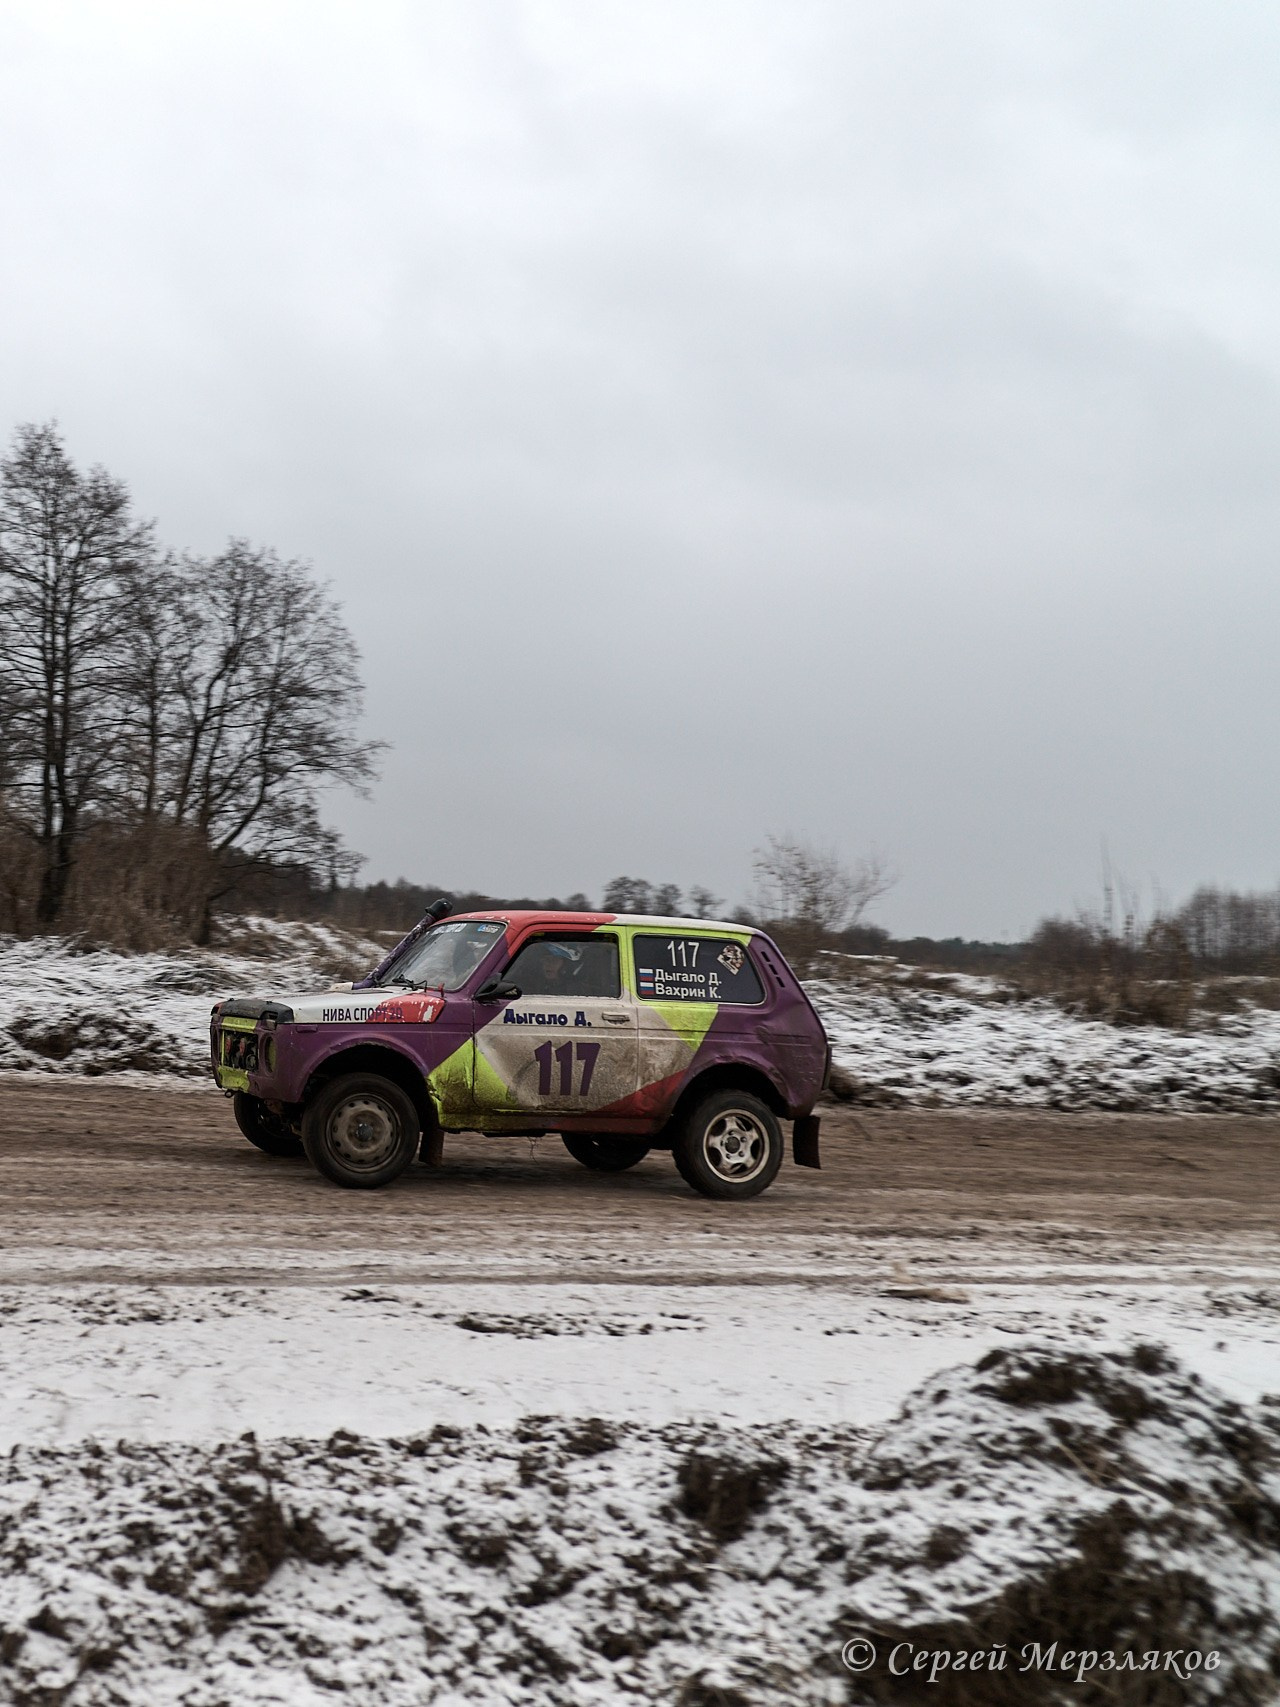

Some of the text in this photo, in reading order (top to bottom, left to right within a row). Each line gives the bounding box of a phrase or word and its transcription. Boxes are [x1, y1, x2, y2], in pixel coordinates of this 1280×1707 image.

[667, 940, 700, 968] 117
[654, 968, 722, 986] Дыгало Д.
[654, 982, 722, 999] Вахрин К.
[322, 1008, 351, 1022] НИВА
[353, 1007, 387, 1021] СПОРТ
[503, 1008, 592, 1027] Дыгало Д.
[534, 1040, 601, 1096] 117
